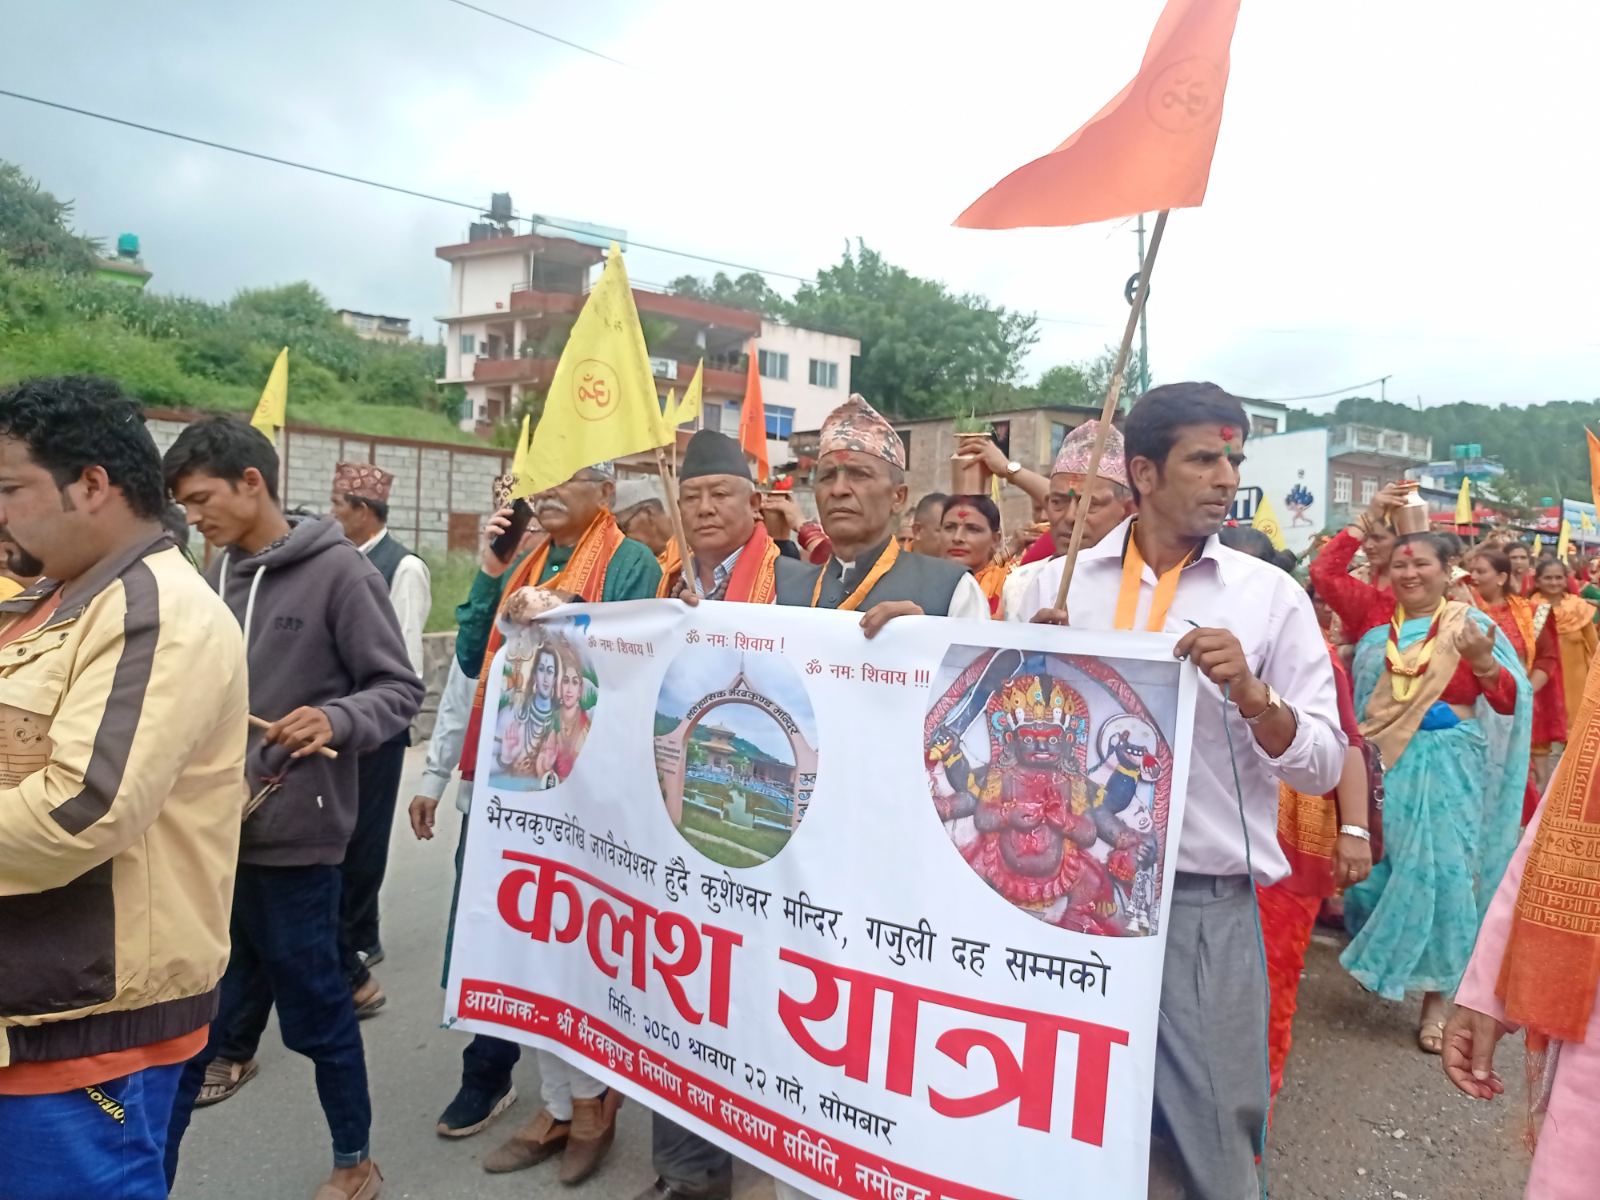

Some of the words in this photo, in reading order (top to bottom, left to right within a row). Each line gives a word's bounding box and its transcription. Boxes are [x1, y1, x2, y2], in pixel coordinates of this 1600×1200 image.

[617, 637, 644, 656] शिवाय
[686, 630, 699, 644] ॐ
[735, 632, 774, 652] शिवाय
[806, 659, 822, 675] ॐ
[862, 663, 907, 685] शिवाय
[487, 796, 586, 850] भैरवकुण्डदेखि
[700, 870, 772, 919] कुशेश्वर
[783, 891, 848, 950] मन्दिर,
[866, 917, 937, 966] गजुली
[951, 936, 990, 977] दह
[1005, 950, 1111, 998] सम्मको
[497, 849, 744, 1029] कलश
[778, 946, 1130, 1148] यात्रा
[556, 1008, 575, 1038] श्री
[577, 1014, 635, 1074] भैरवकुण्ड
[639, 1049, 682, 1098] निर्माण
[687, 1082, 715, 1114] तथा
[720, 1097, 777, 1149] संरक्षण
[783, 1128, 844, 1188] समिति,
[643, 1014, 680, 1050] २०८०
[688, 1036, 736, 1076] श्रावण
[744, 1062, 767, 1095] २२
[776, 1075, 807, 1115] गते,
[819, 1091, 897, 1146] सोमबार
